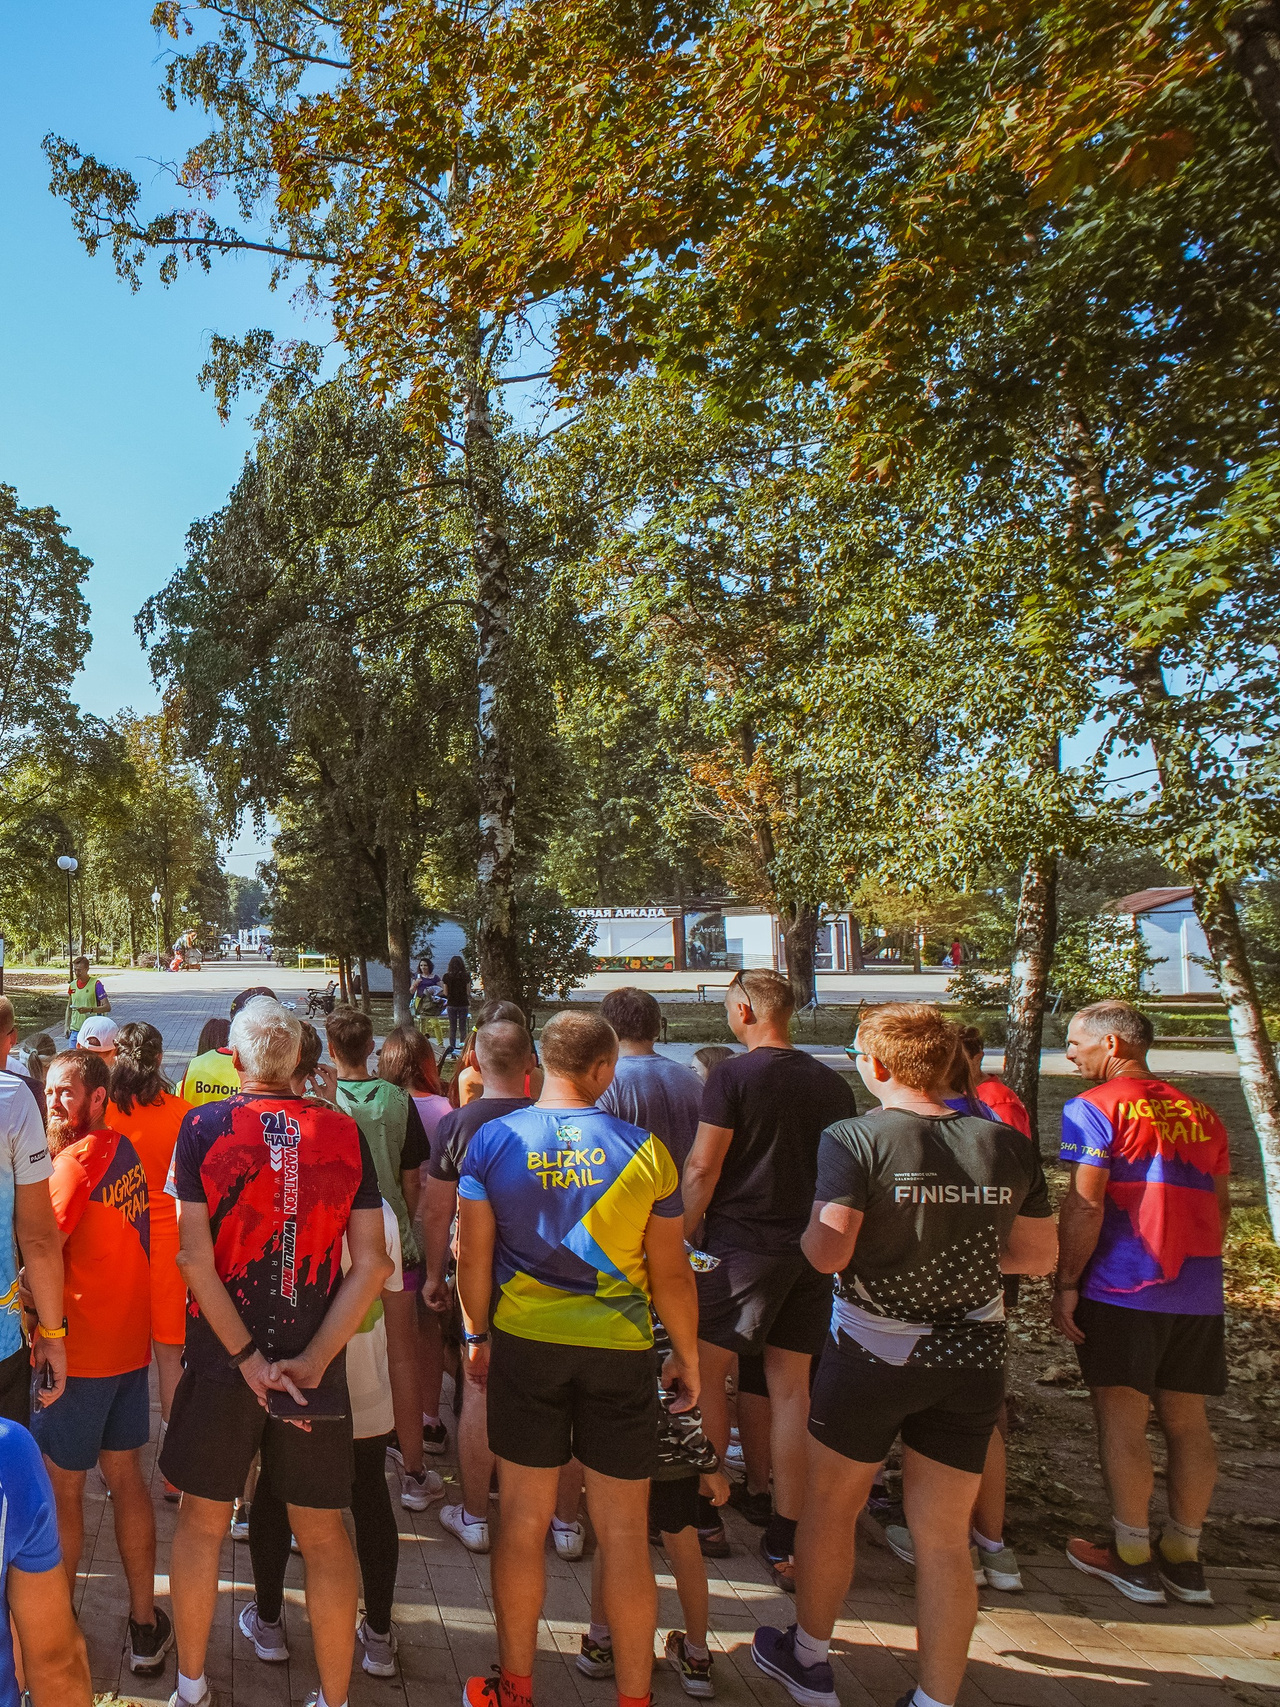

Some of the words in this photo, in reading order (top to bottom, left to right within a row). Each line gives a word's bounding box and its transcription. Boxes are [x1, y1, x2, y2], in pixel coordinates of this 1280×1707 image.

[614, 908, 667, 918] АРКАДА
[196, 1081, 241, 1095] Волон
[1118, 1099, 1214, 1124] UGRESHA
[264, 1132, 300, 1147] HALF
[1151, 1121, 1211, 1144] TRAIL
[527, 1148, 606, 1170] BLIZKO
[1081, 1146, 1110, 1158] TRAIL
[284, 1146, 298, 1214] MARATHON
[536, 1168, 603, 1190] TRAIL
[894, 1185, 1013, 1205] FINISHER
[119, 1190, 150, 1229] TRAIL
[272, 1177, 281, 1240] WORLD
[270, 1260, 279, 1295] RUN
